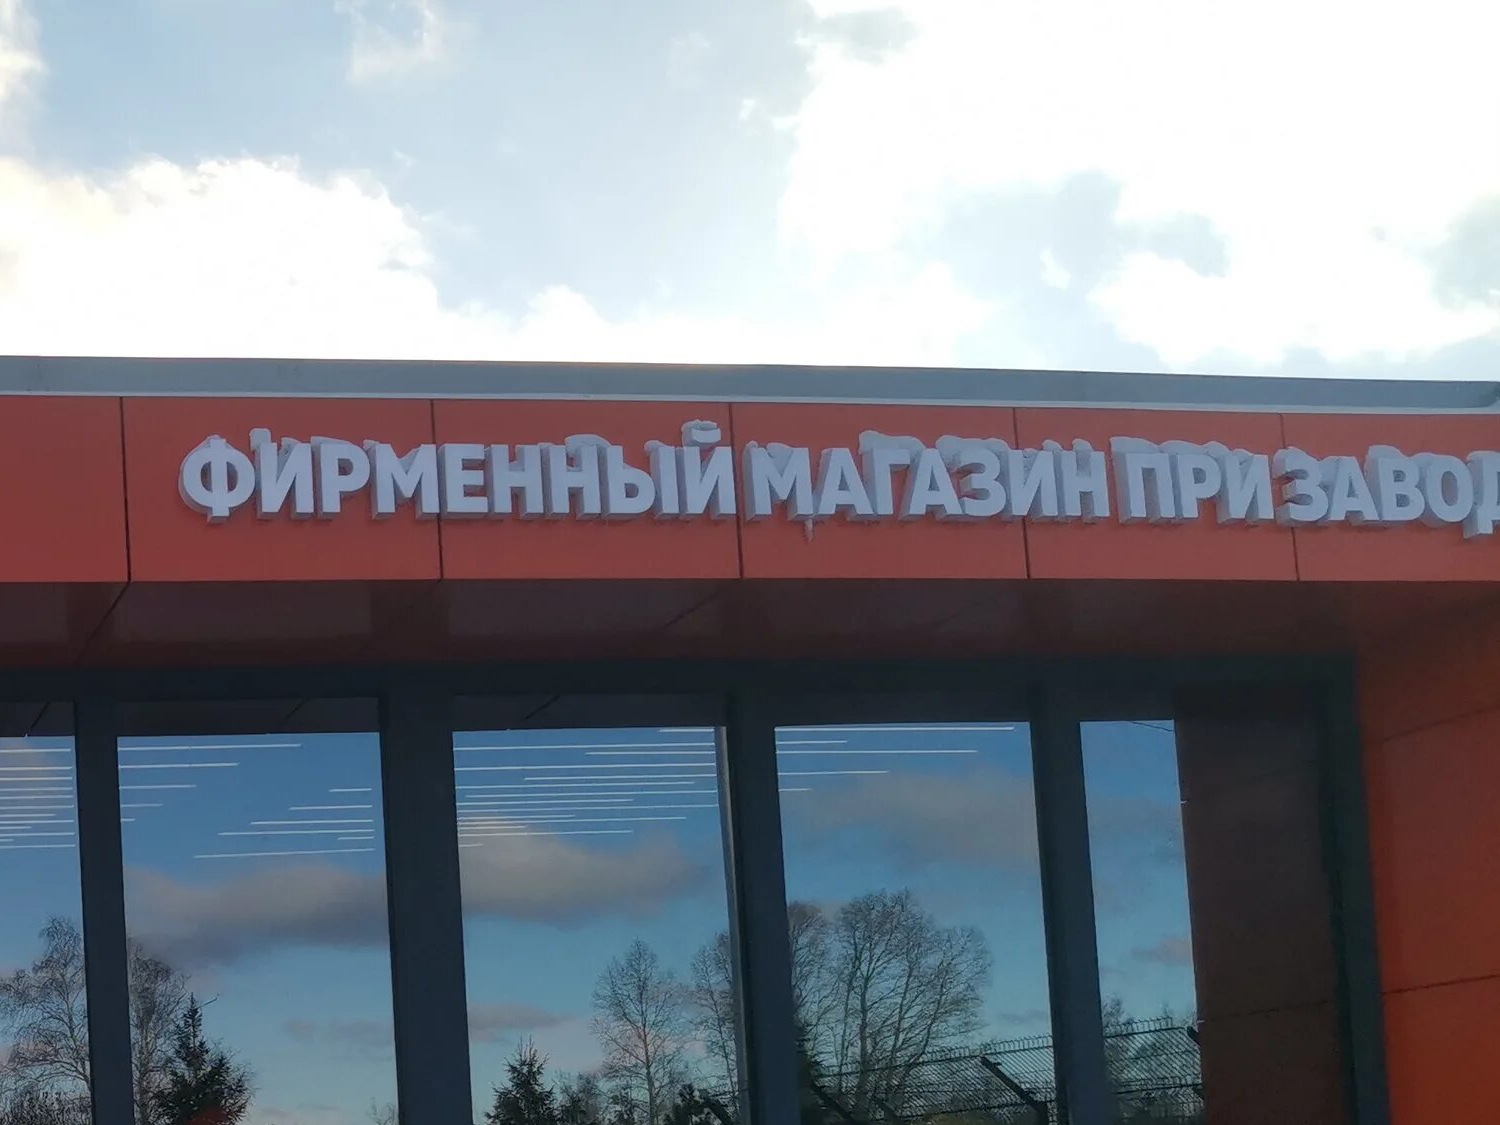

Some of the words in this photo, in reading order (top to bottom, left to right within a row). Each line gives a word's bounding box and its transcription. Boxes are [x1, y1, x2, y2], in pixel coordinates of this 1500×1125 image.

[179, 424, 736, 522] ФИРМЕННЫЙ
[744, 443, 1110, 521] МАГАЗИН
[1114, 450, 1275, 523] ПРИ
